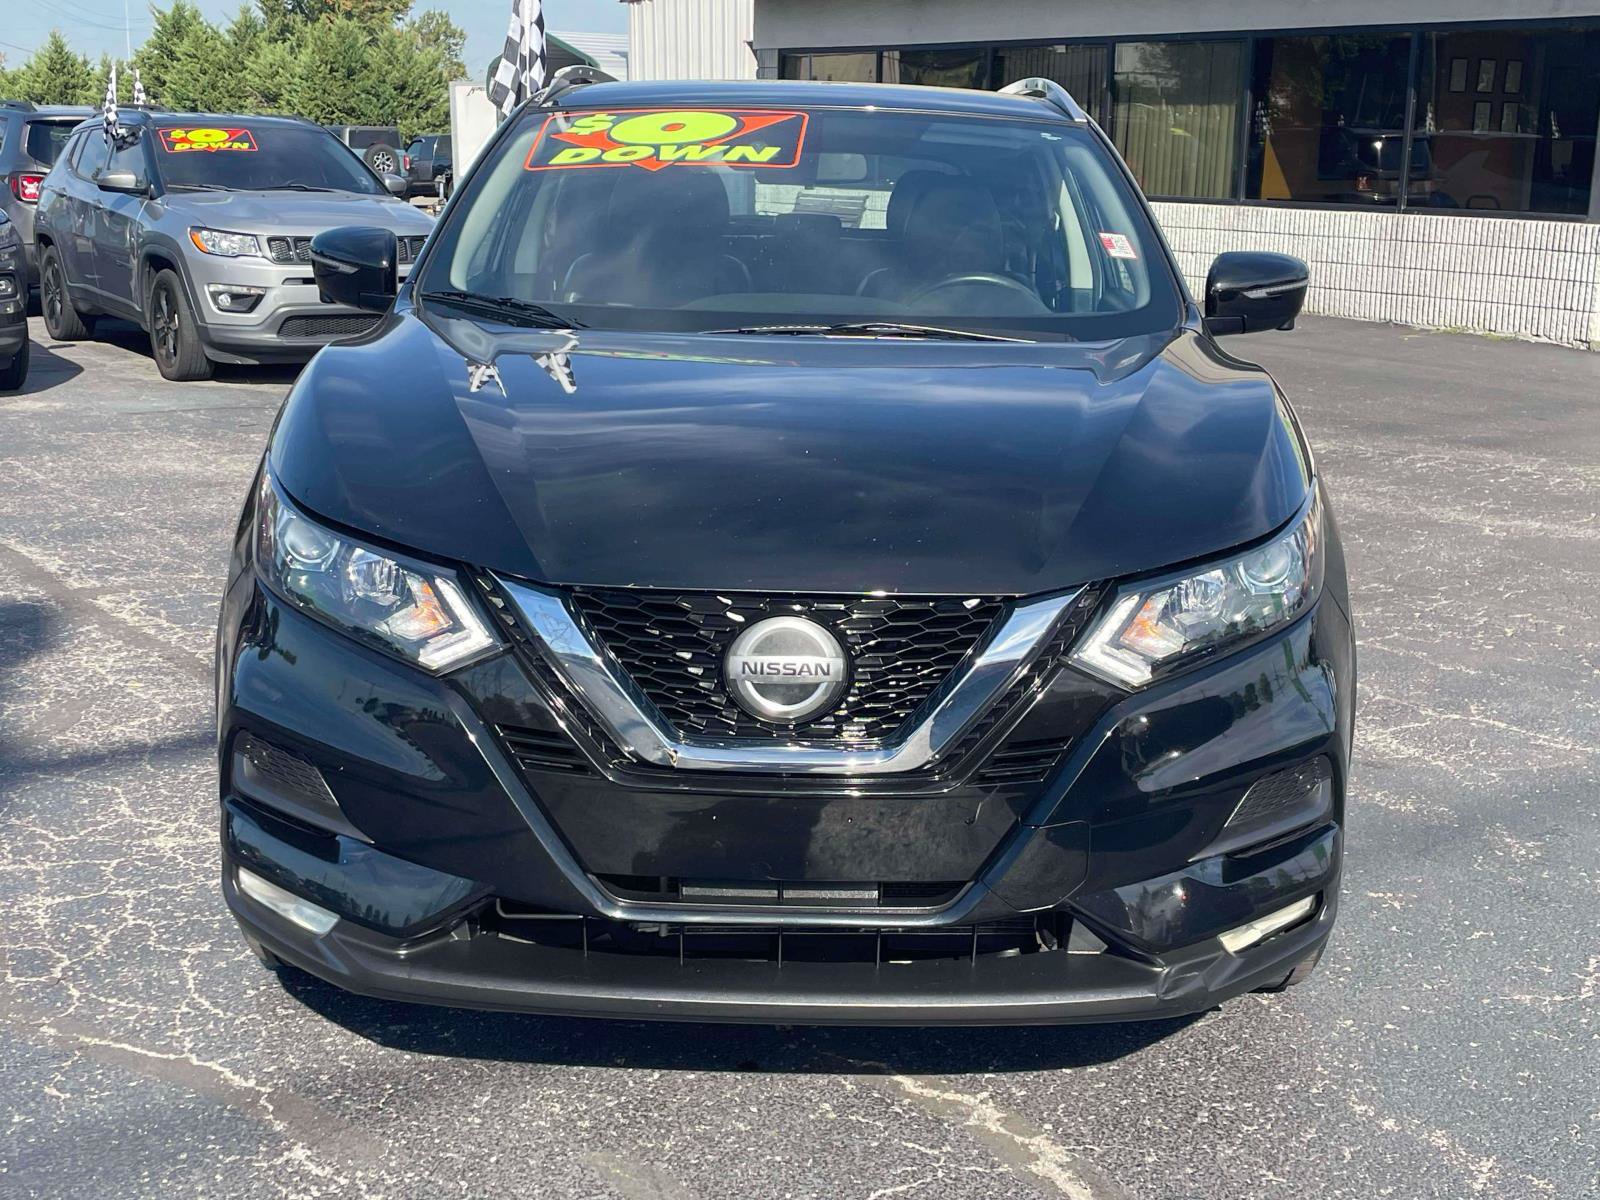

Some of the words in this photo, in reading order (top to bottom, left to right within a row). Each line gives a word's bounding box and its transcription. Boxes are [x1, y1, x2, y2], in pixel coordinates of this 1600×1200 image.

[568, 111, 738, 144] $0
[174, 142, 249, 151] DOWN
[548, 145, 782, 164] DOWN
[741, 661, 831, 676] NISSAN
